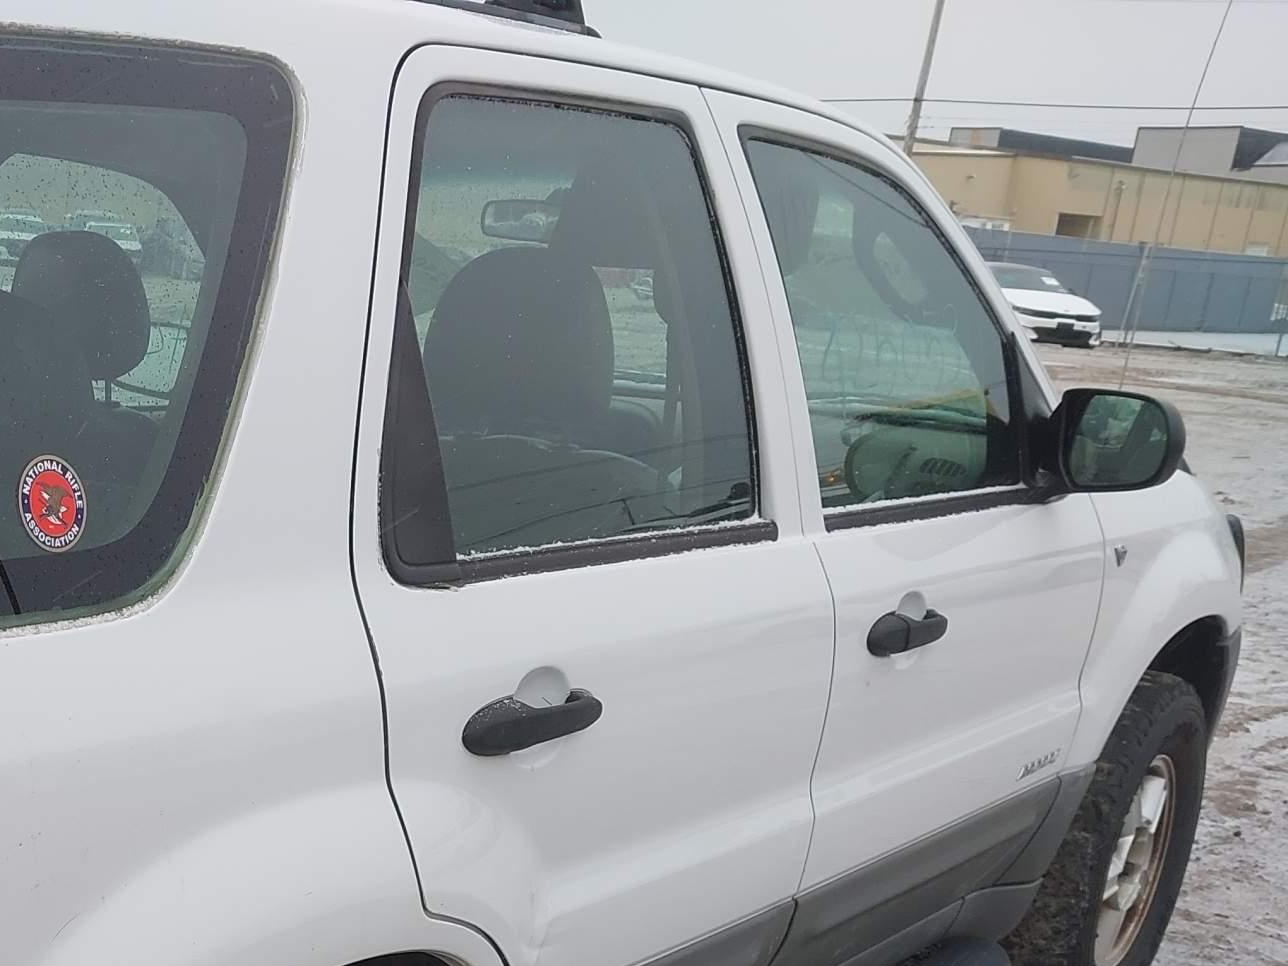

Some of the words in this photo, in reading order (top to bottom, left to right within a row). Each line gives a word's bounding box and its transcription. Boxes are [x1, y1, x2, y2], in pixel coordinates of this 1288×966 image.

[22, 460, 64, 495] NATIONAL
[64, 471, 83, 508] RIFLE
[24, 512, 80, 547] ASSOCIATION
